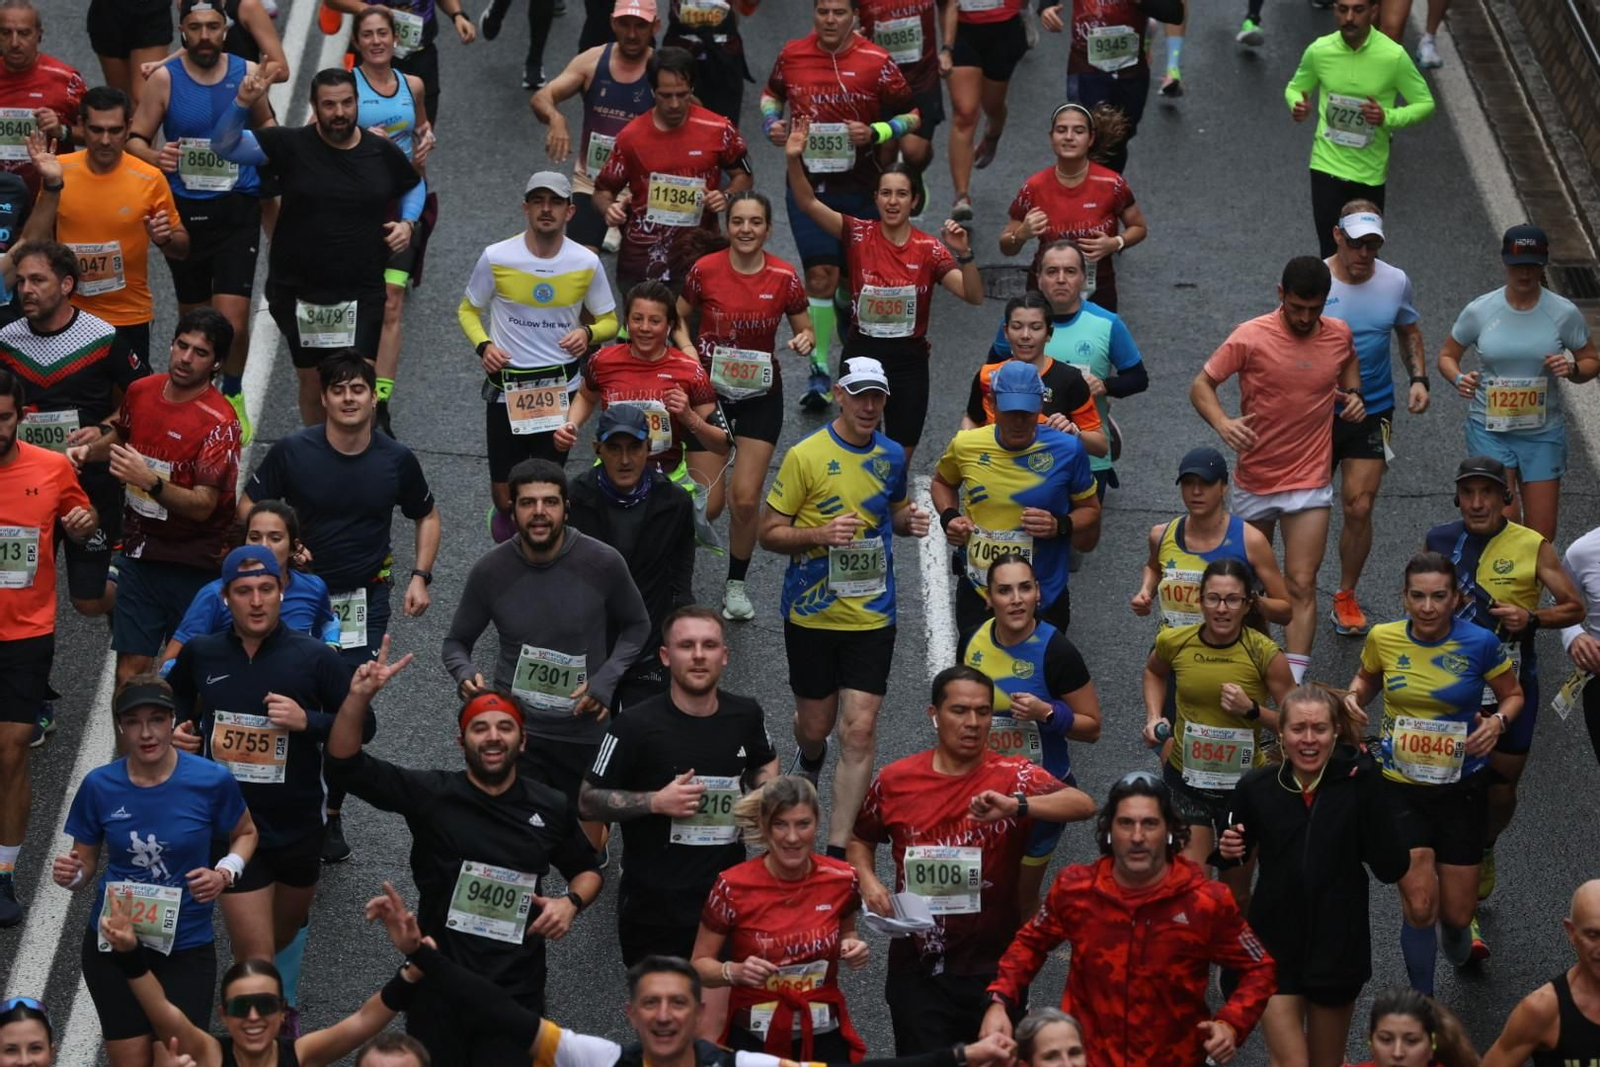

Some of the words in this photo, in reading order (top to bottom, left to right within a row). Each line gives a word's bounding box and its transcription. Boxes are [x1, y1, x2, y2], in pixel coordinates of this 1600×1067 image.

[1095, 37, 1128, 54] 9345
[1330, 105, 1366, 128] 7275
[809, 135, 843, 151] 8353
[187, 150, 225, 169] 8508
[653, 185, 697, 206] 11384
[80, 255, 107, 274] 047
[867, 299, 903, 317] 7636
[508, 317, 541, 328] FOLLOW
[515, 392, 555, 411] 4249
[1489, 390, 1539, 409] 12270
[24, 426, 65, 446] 8509
[1, 542, 21, 561] 13
[839, 553, 878, 572] 9231
[1163, 583, 1203, 605] 1072
[333, 603, 351, 622] 62
[528, 662, 571, 687] 7301
[222, 729, 270, 753] 5755
[986, 730, 1025, 751] 508
[1399, 733, 1455, 756] 10846
[1190, 739, 1237, 763] 8547
[700, 794, 732, 815] 216
[915, 862, 962, 886] 8108
[466, 879, 517, 909] 9409
[122, 901, 158, 924] 24
